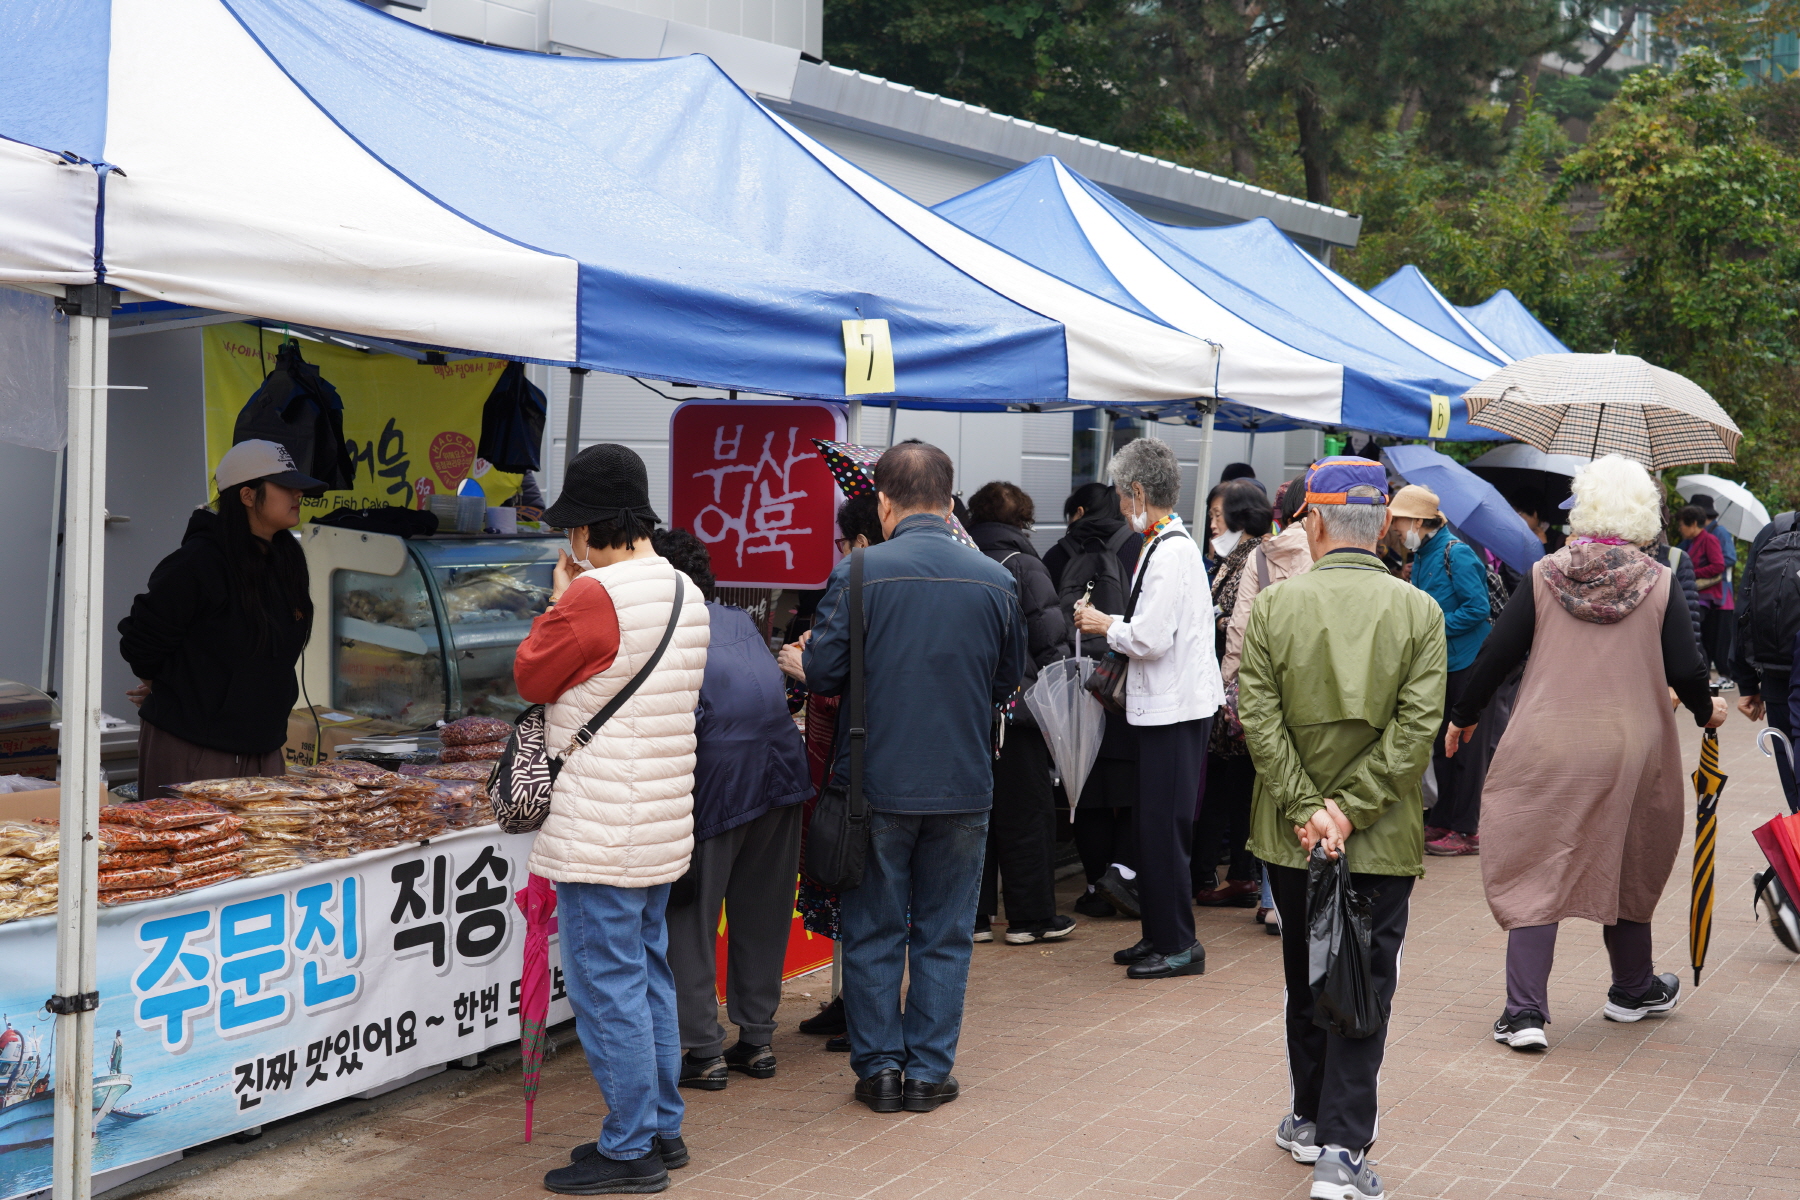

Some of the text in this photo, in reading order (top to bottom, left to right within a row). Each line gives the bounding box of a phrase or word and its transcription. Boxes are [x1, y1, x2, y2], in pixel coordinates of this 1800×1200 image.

[433, 364, 483, 380] 백화점에서
[861, 333, 874, 381] 7
[1437, 402, 1444, 431] 6
[432, 434, 472, 454] HACCP
[692, 424, 818, 507] 부산
[298, 495, 390, 510] usan Fish Cake
[693, 483, 813, 570] 어묵
[301, 741, 316, 753] 1965
[136, 844, 509, 1045] 주문진 직송
[235, 1049, 298, 1110] 진짜
[305, 1010, 418, 1088] 맛있어요
[453, 982, 500, 1038] 한번
[507, 966, 568, 1017] 드보
